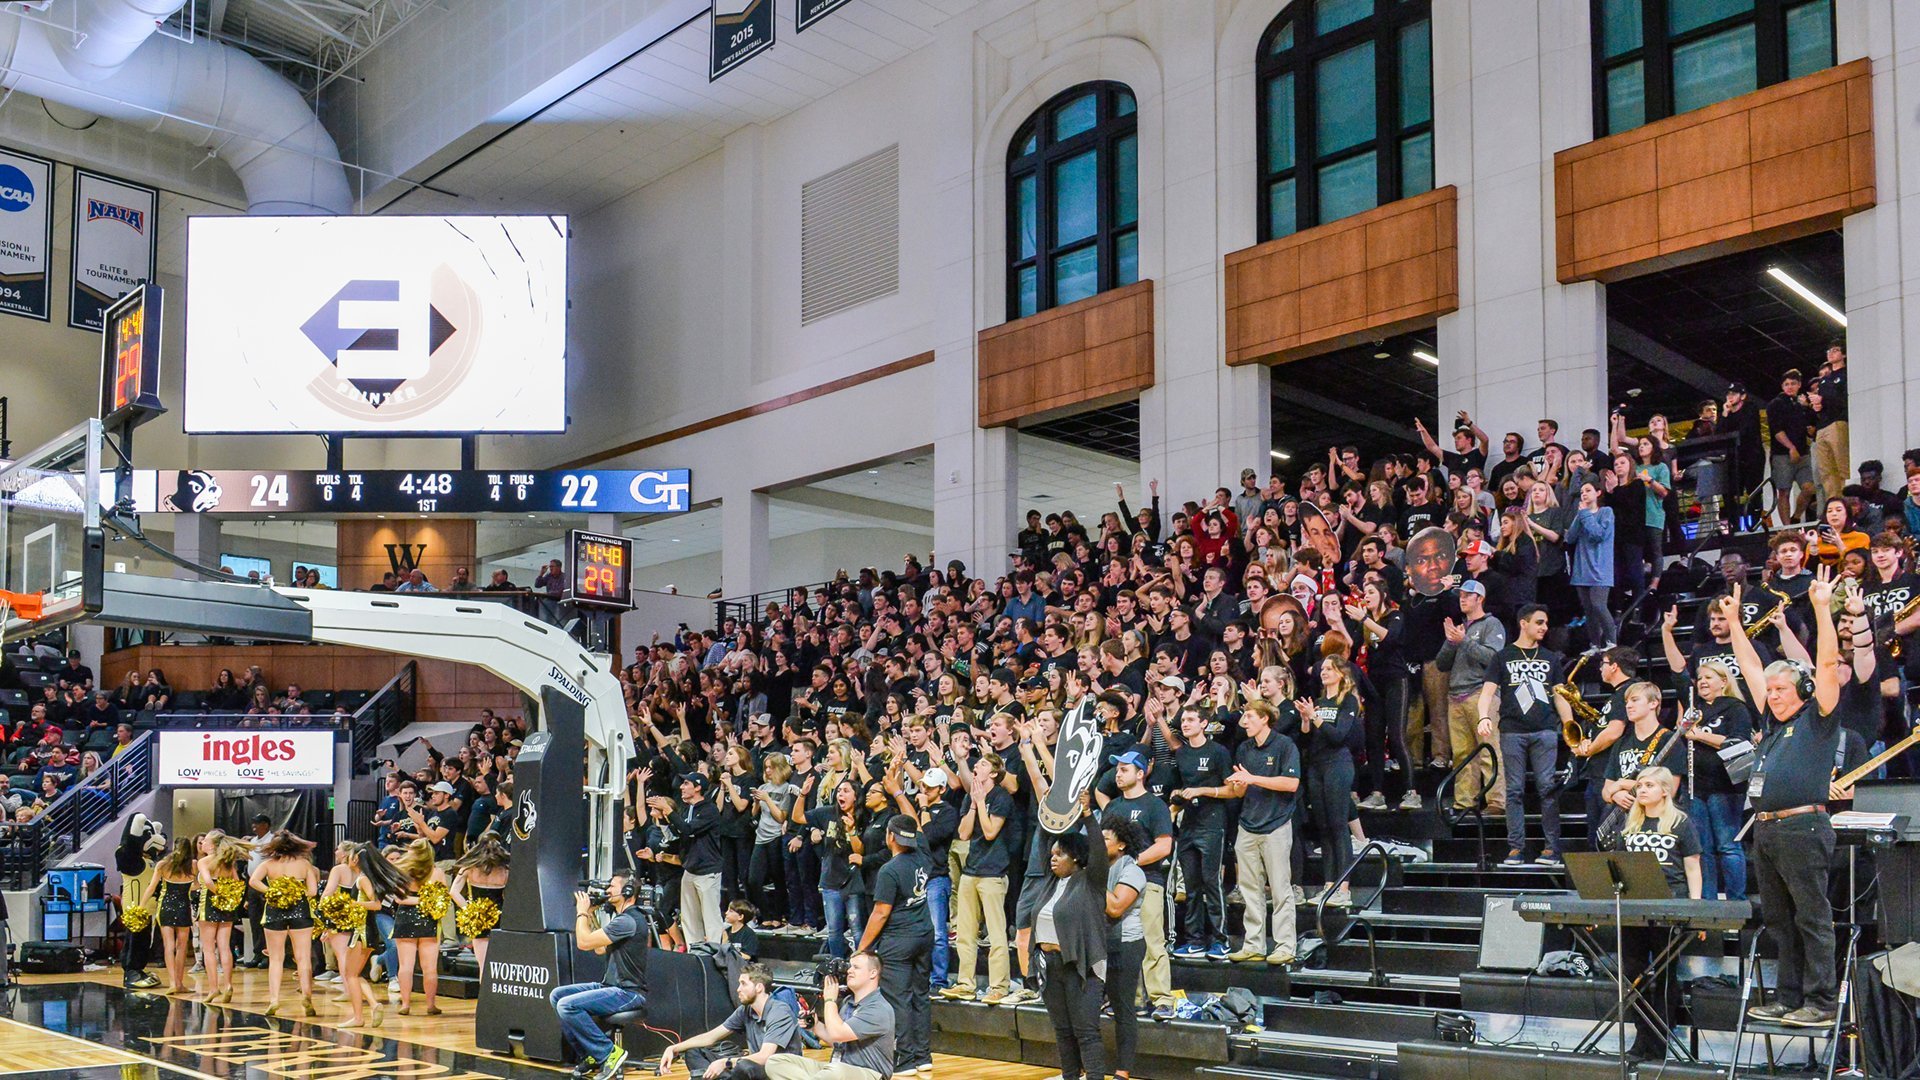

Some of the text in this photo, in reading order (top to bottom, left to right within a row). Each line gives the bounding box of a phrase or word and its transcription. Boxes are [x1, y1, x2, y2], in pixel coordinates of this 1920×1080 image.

[731, 24, 753, 48] 2015
[0, 185, 33, 205] CAA
[90, 200, 142, 230] NAIA
[0, 240, 22, 251] SION
[86, 269, 137, 286] TOURNAMEN
[100, 263, 121, 275] ELITE
[316, 475, 363, 485] FOULS TOL
[399, 474, 452, 494] 4:48
[488, 475, 534, 485] TOL FOULS
[251, 475, 288, 507] 24
[323, 485, 361, 501] 6 4
[490, 485, 527, 501] 4 6
[561, 475, 598, 507] 22
[629, 472, 689, 510] GT
[417, 499, 437, 512] 1ST
[581, 534, 622, 546] DAKTRONICS
[384, 544, 427, 580] W
[586, 543, 623, 567] 4:48
[585, 565, 615, 592] 29
[1506, 661, 1550, 674] WOCO
[1511, 672, 1546, 684] BAND
[548, 666, 592, 708] SPALDING
[203, 734, 296, 765] ingles
[178, 768, 201, 777] LOW
[237, 768, 264, 777] LOVE
[1528, 903, 1552, 911] YAMAHA
[490, 961, 549, 985] WOFFORD
[492, 983, 544, 999] BASKETBALL
